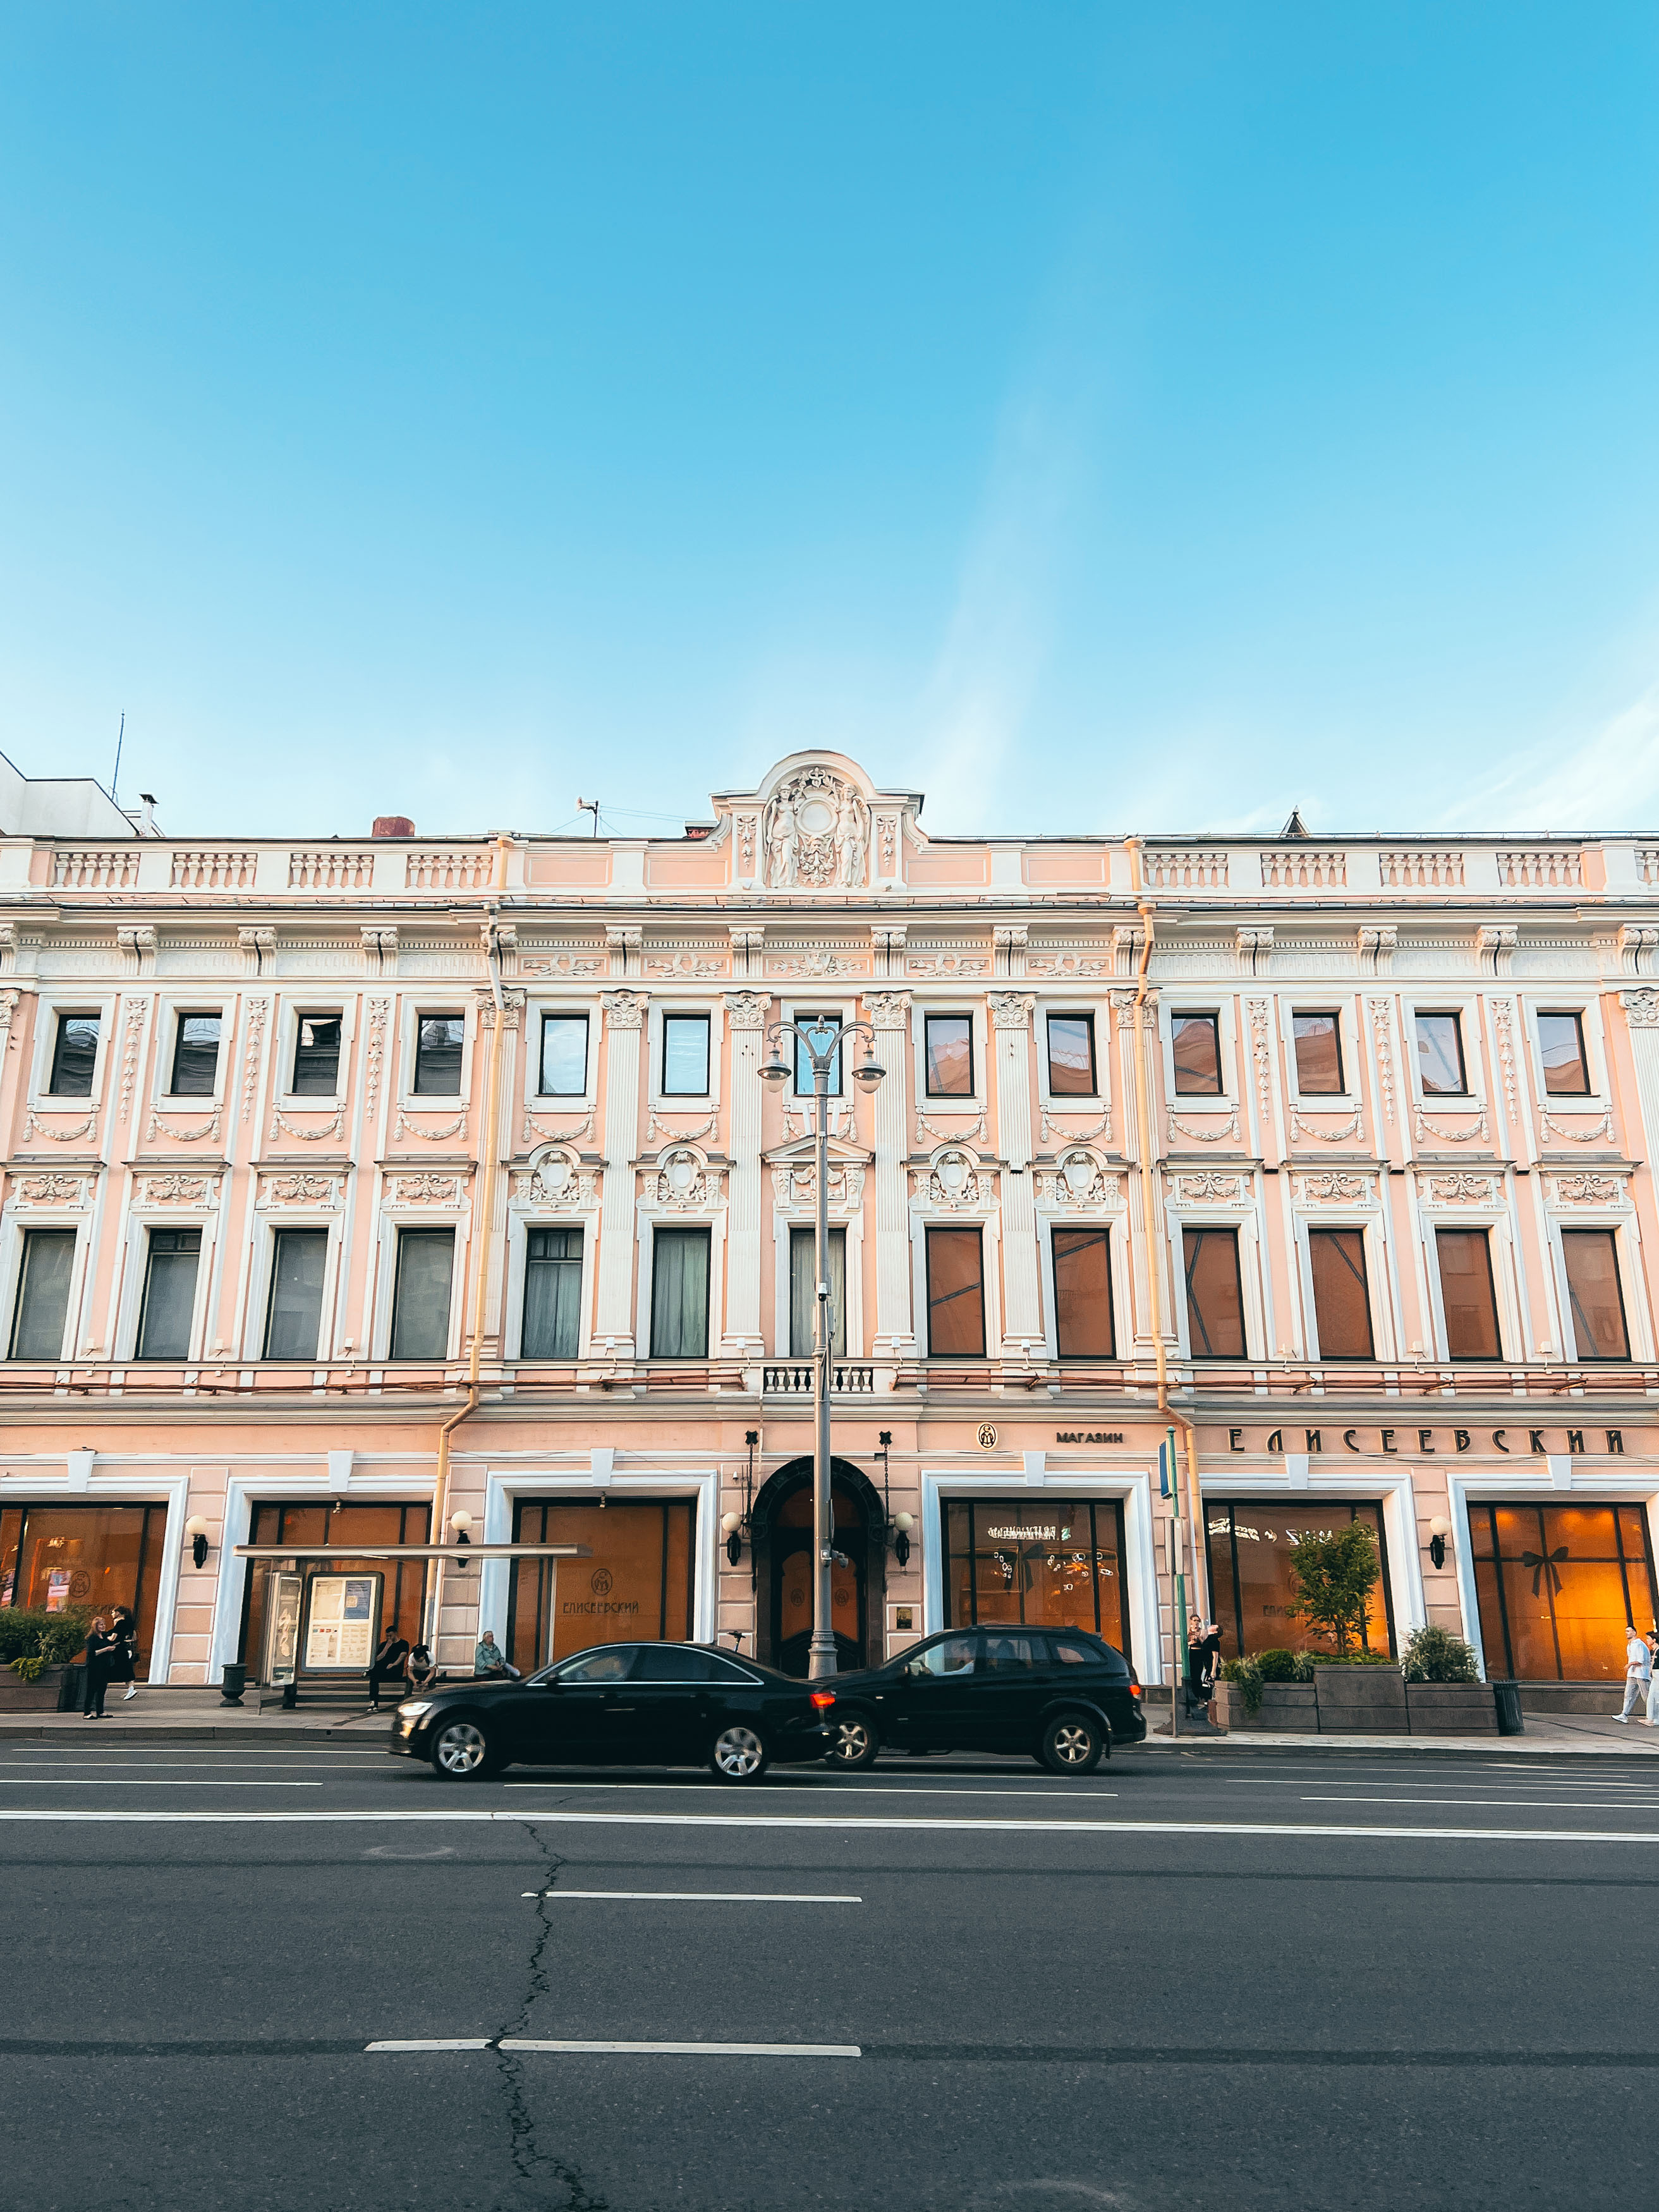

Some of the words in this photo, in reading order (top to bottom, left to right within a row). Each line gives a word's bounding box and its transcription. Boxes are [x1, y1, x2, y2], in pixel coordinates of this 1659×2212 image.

[1056, 1432, 1123, 1443] МАГАЗИН
[1228, 1428, 1624, 1453] ЕЛИСЕЕВСКИЙ
[563, 1601, 639, 1613] ЕЛИСЕЕВСКИЙ
